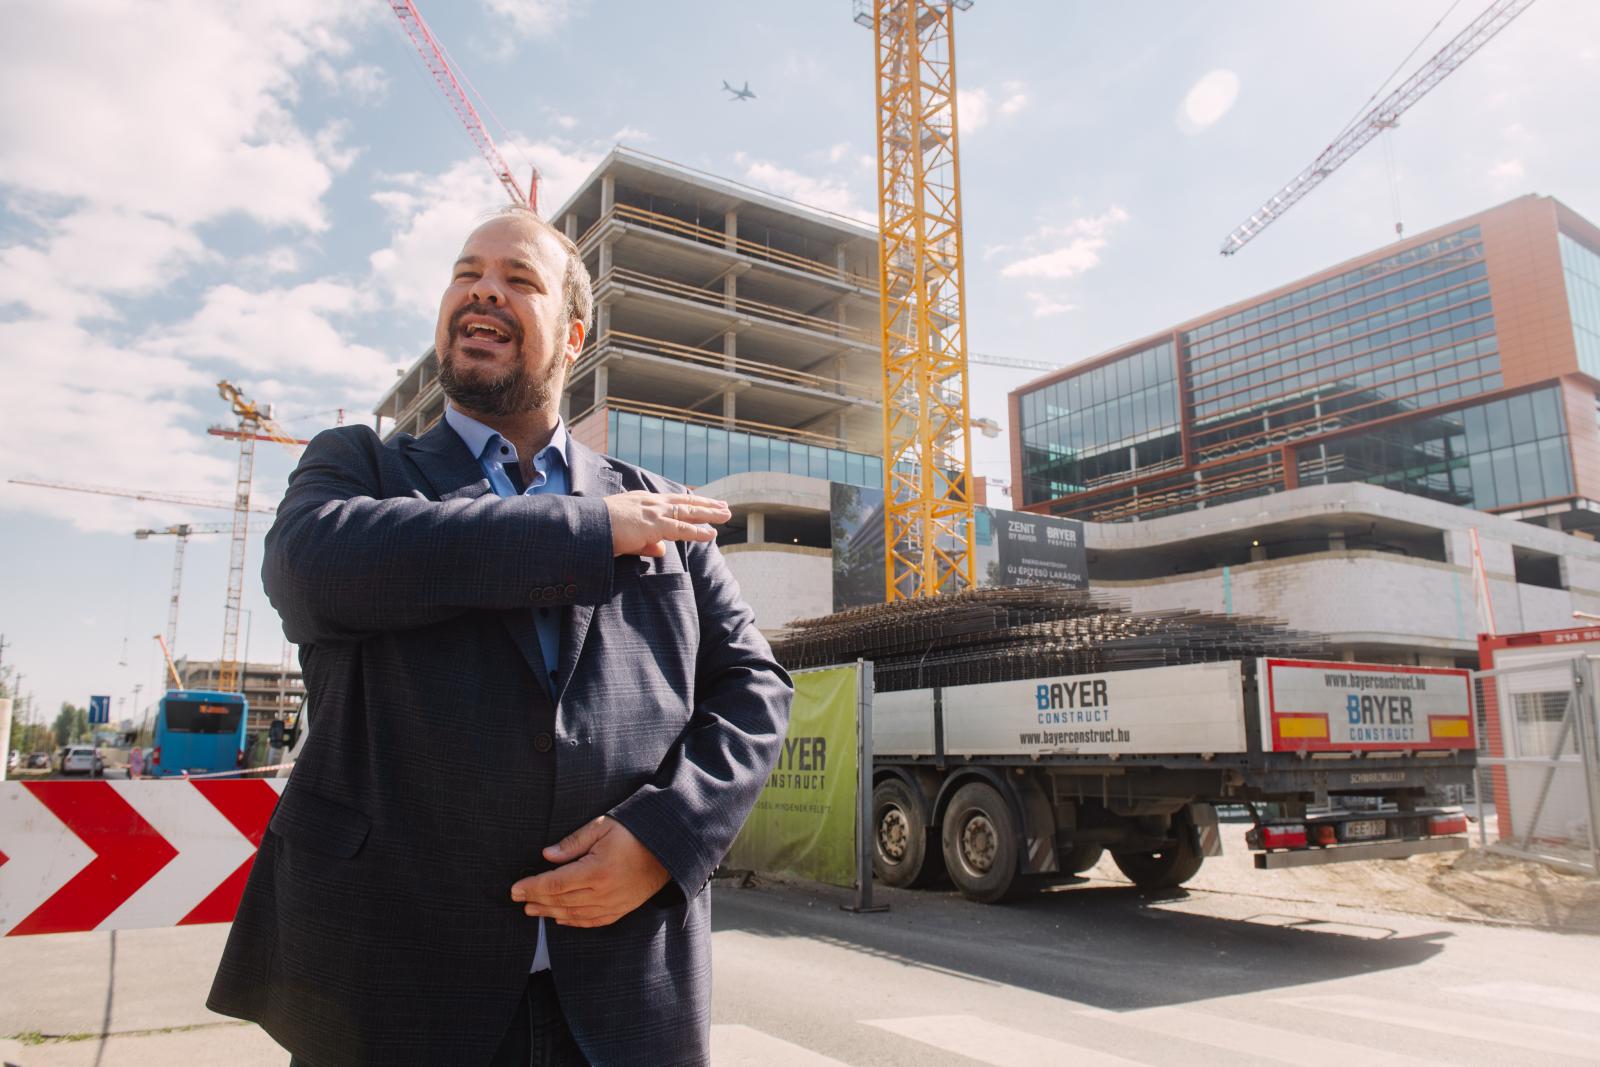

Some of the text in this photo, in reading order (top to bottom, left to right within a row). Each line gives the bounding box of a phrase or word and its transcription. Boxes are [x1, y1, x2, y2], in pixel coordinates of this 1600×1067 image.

[1008, 521, 1036, 534] ZENIT
[1046, 526, 1076, 541] BAYER
[1324, 673, 1427, 691] www.bayerconstruct.hu
[1035, 679, 1108, 710] BAYER
[1038, 709, 1109, 724] CONSTRUCT
[1346, 694, 1414, 725] BAYER
[1020, 728, 1130, 746] www.bayerconstruct.hu
[1350, 728, 1415, 741] CONSTRUCT
[777, 737, 826, 771] YER
[765, 774, 825, 790] NSTRUCT
